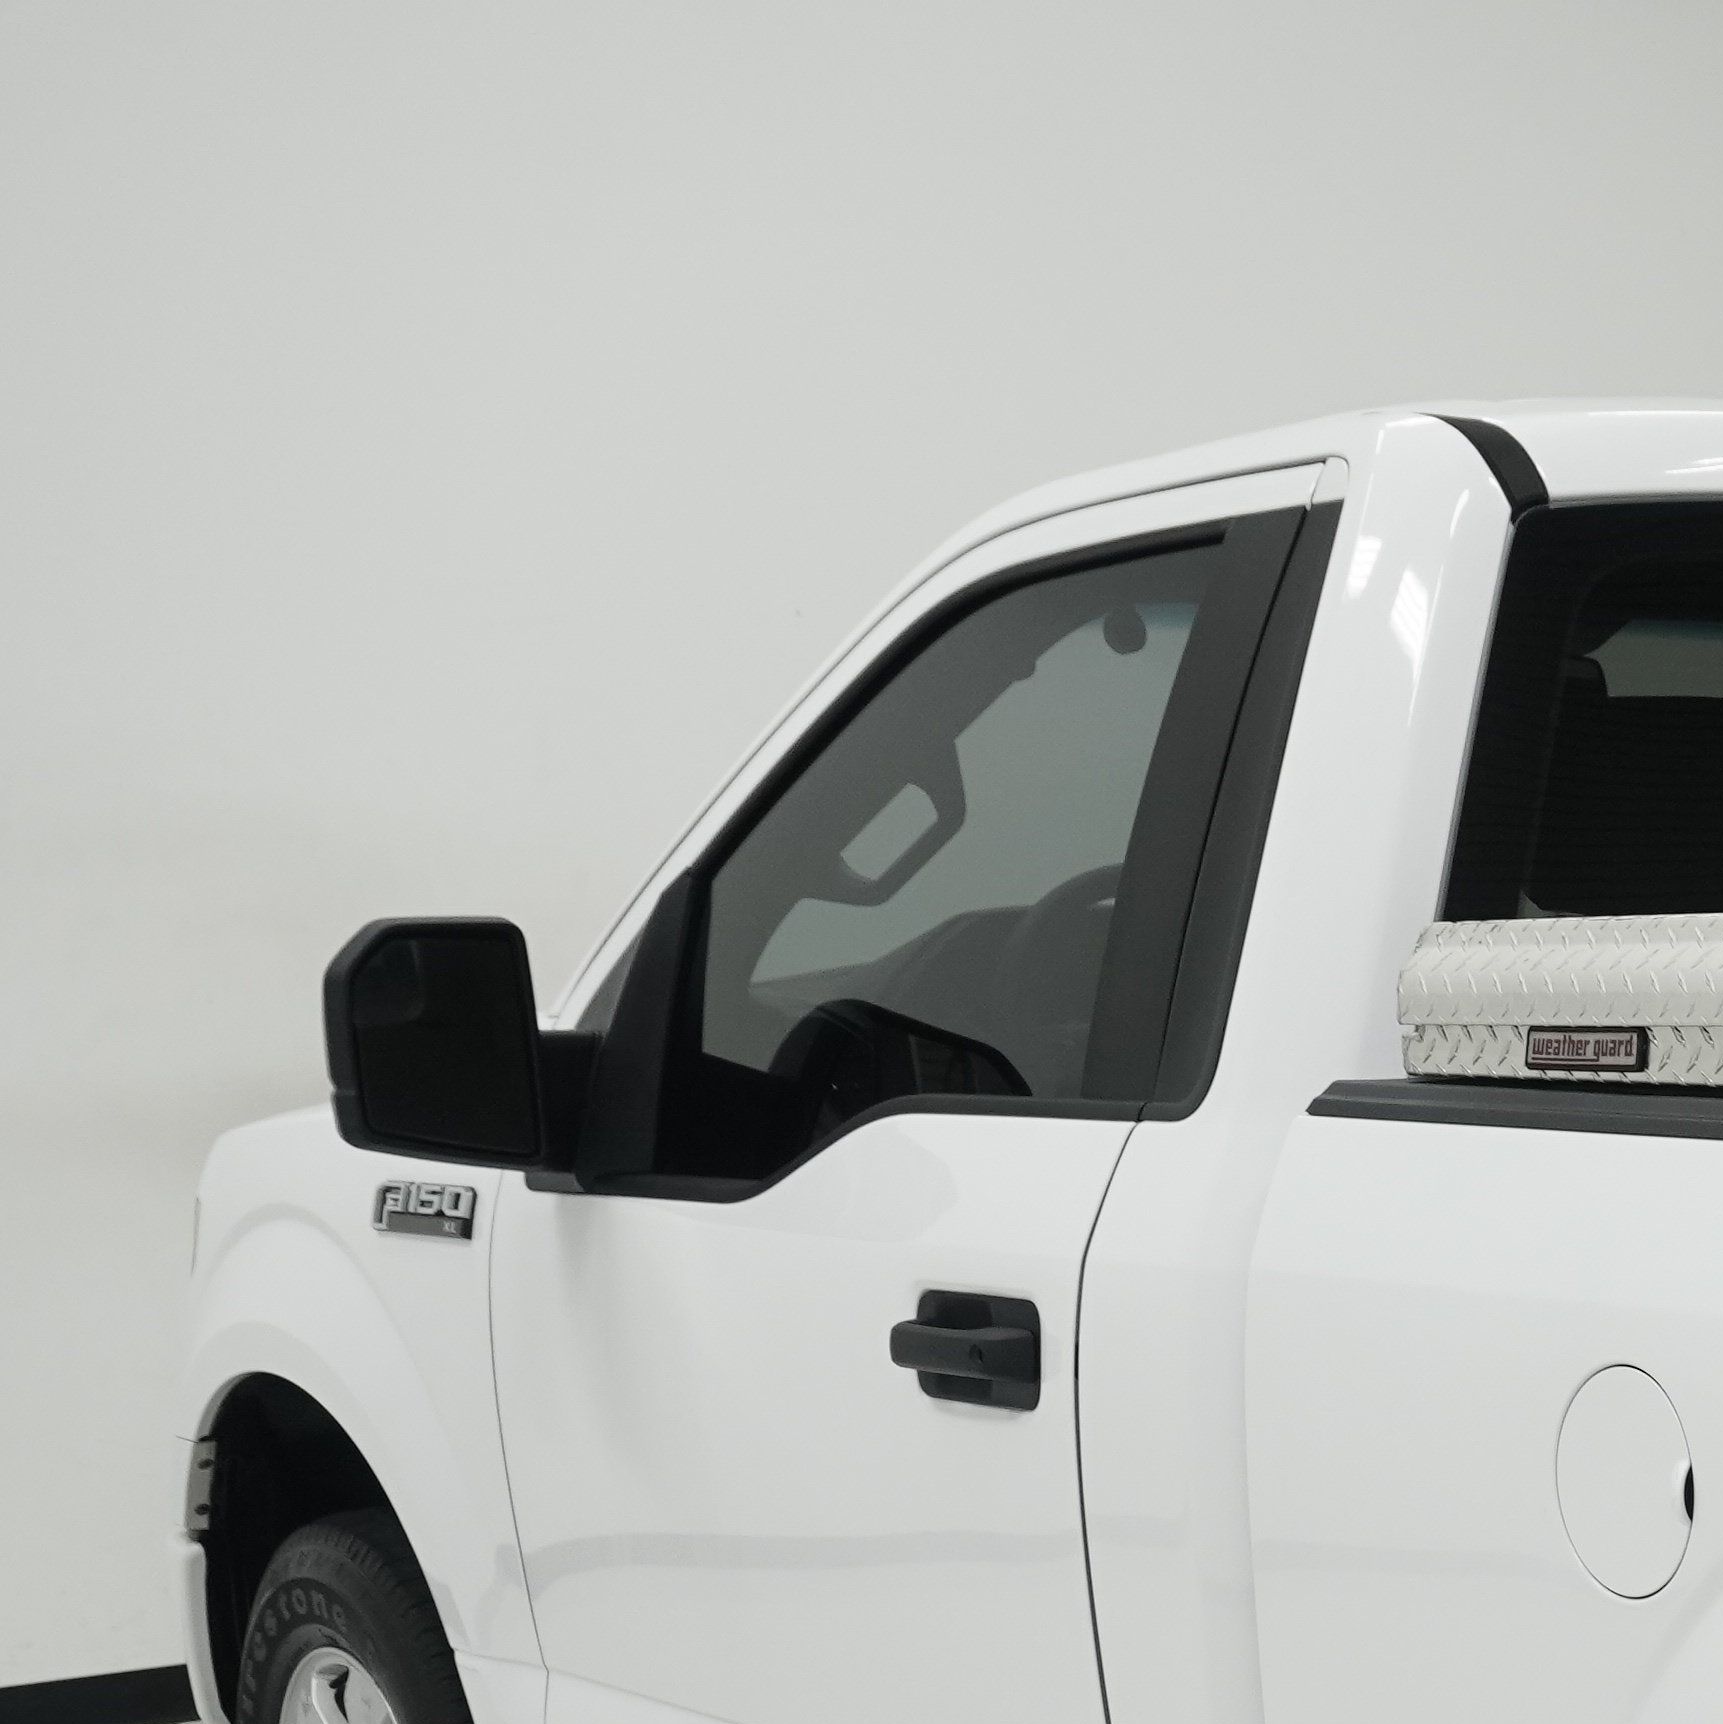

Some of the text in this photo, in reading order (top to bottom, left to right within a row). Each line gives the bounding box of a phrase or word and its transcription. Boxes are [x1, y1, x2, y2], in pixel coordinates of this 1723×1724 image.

[1532, 1035, 1634, 1061] weather guard
[442, 1221, 457, 1234] XL
